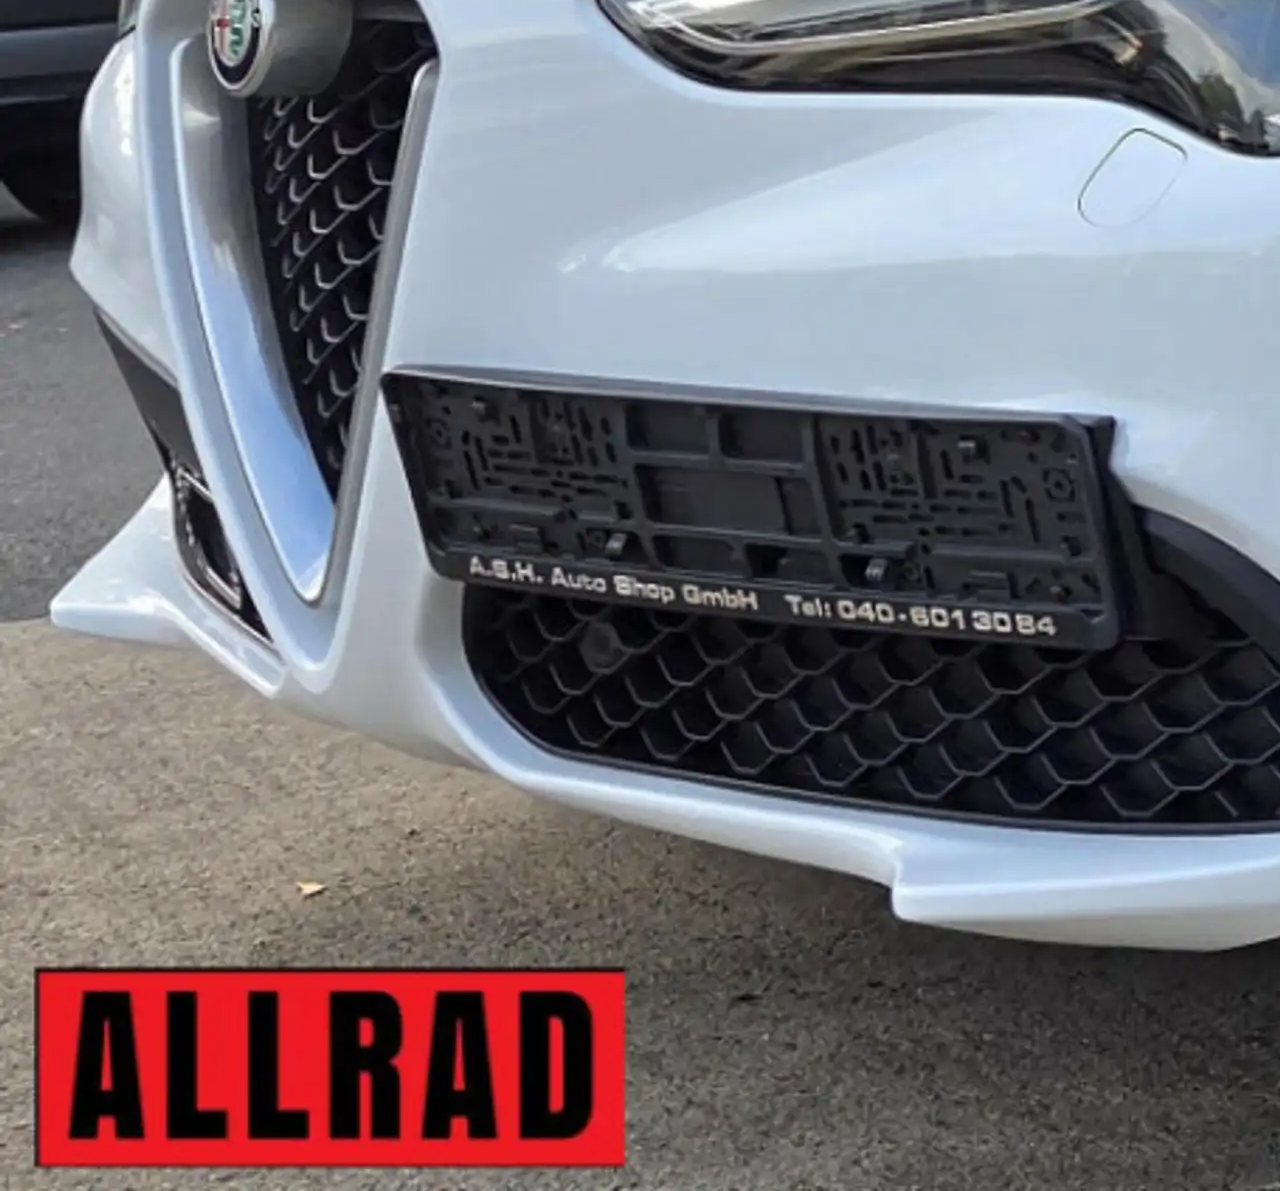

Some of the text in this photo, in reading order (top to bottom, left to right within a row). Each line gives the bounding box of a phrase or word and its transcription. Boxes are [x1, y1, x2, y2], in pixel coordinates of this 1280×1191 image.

[469, 555, 543, 583] A.S.H.
[551, 566, 607, 594] Auto
[612, 574, 676, 604] Shop
[681, 583, 760, 611] GmbH
[783, 594, 832, 619] Tel:
